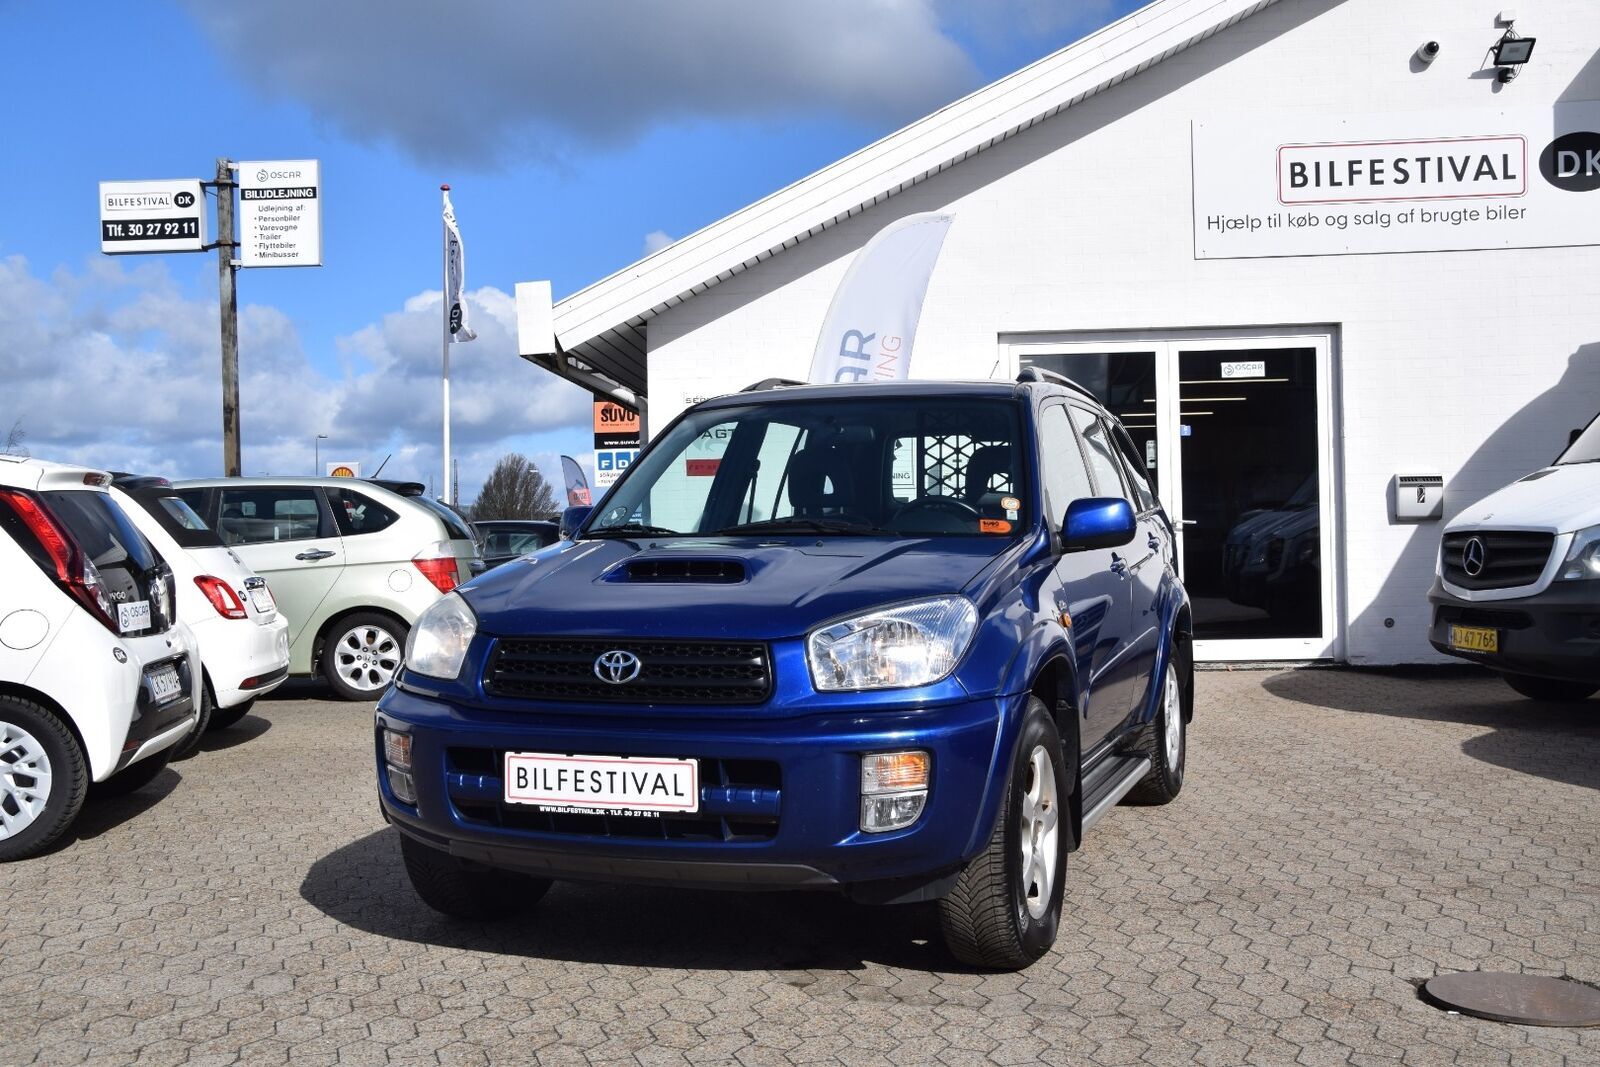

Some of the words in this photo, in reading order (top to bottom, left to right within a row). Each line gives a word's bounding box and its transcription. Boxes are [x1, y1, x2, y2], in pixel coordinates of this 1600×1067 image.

[1289, 153, 1517, 189] BILFESTIVAL
[1557, 149, 1600, 178] DK
[270, 171, 301, 179] OSCAR
[245, 188, 313, 199] BILUDLEJNING
[108, 197, 170, 207] BILFESTIVAL
[177, 196, 191, 204] DK
[258, 205, 293, 213] Udlejning
[1207, 214, 1261, 233] Hjælp
[1267, 212, 1282, 229] til
[1287, 212, 1319, 229] køb
[1325, 214, 1348, 230] og
[1354, 210, 1391, 228] salg
[1397, 208, 1415, 224] af
[1421, 207, 1480, 226] brugte
[1486, 205, 1526, 222] biler
[106, 223, 125, 237] Tlf.
[128, 223, 143, 236] 30
[146, 223, 162, 236] 27
[164, 222, 179, 235] 92
[183, 221, 195, 234] 11
[258, 224, 298, 232] Varevogne
[258, 242, 296, 250] Flyttebiler
[873, 335, 902, 383] ING
[1234, 363, 1263, 371] OSCAR
[600, 408, 635, 422] SUVO
[516, 766, 685, 797] BILFESTIVAL
[539, 805, 606, 815] WWW.BILFESTIVAL.DK
